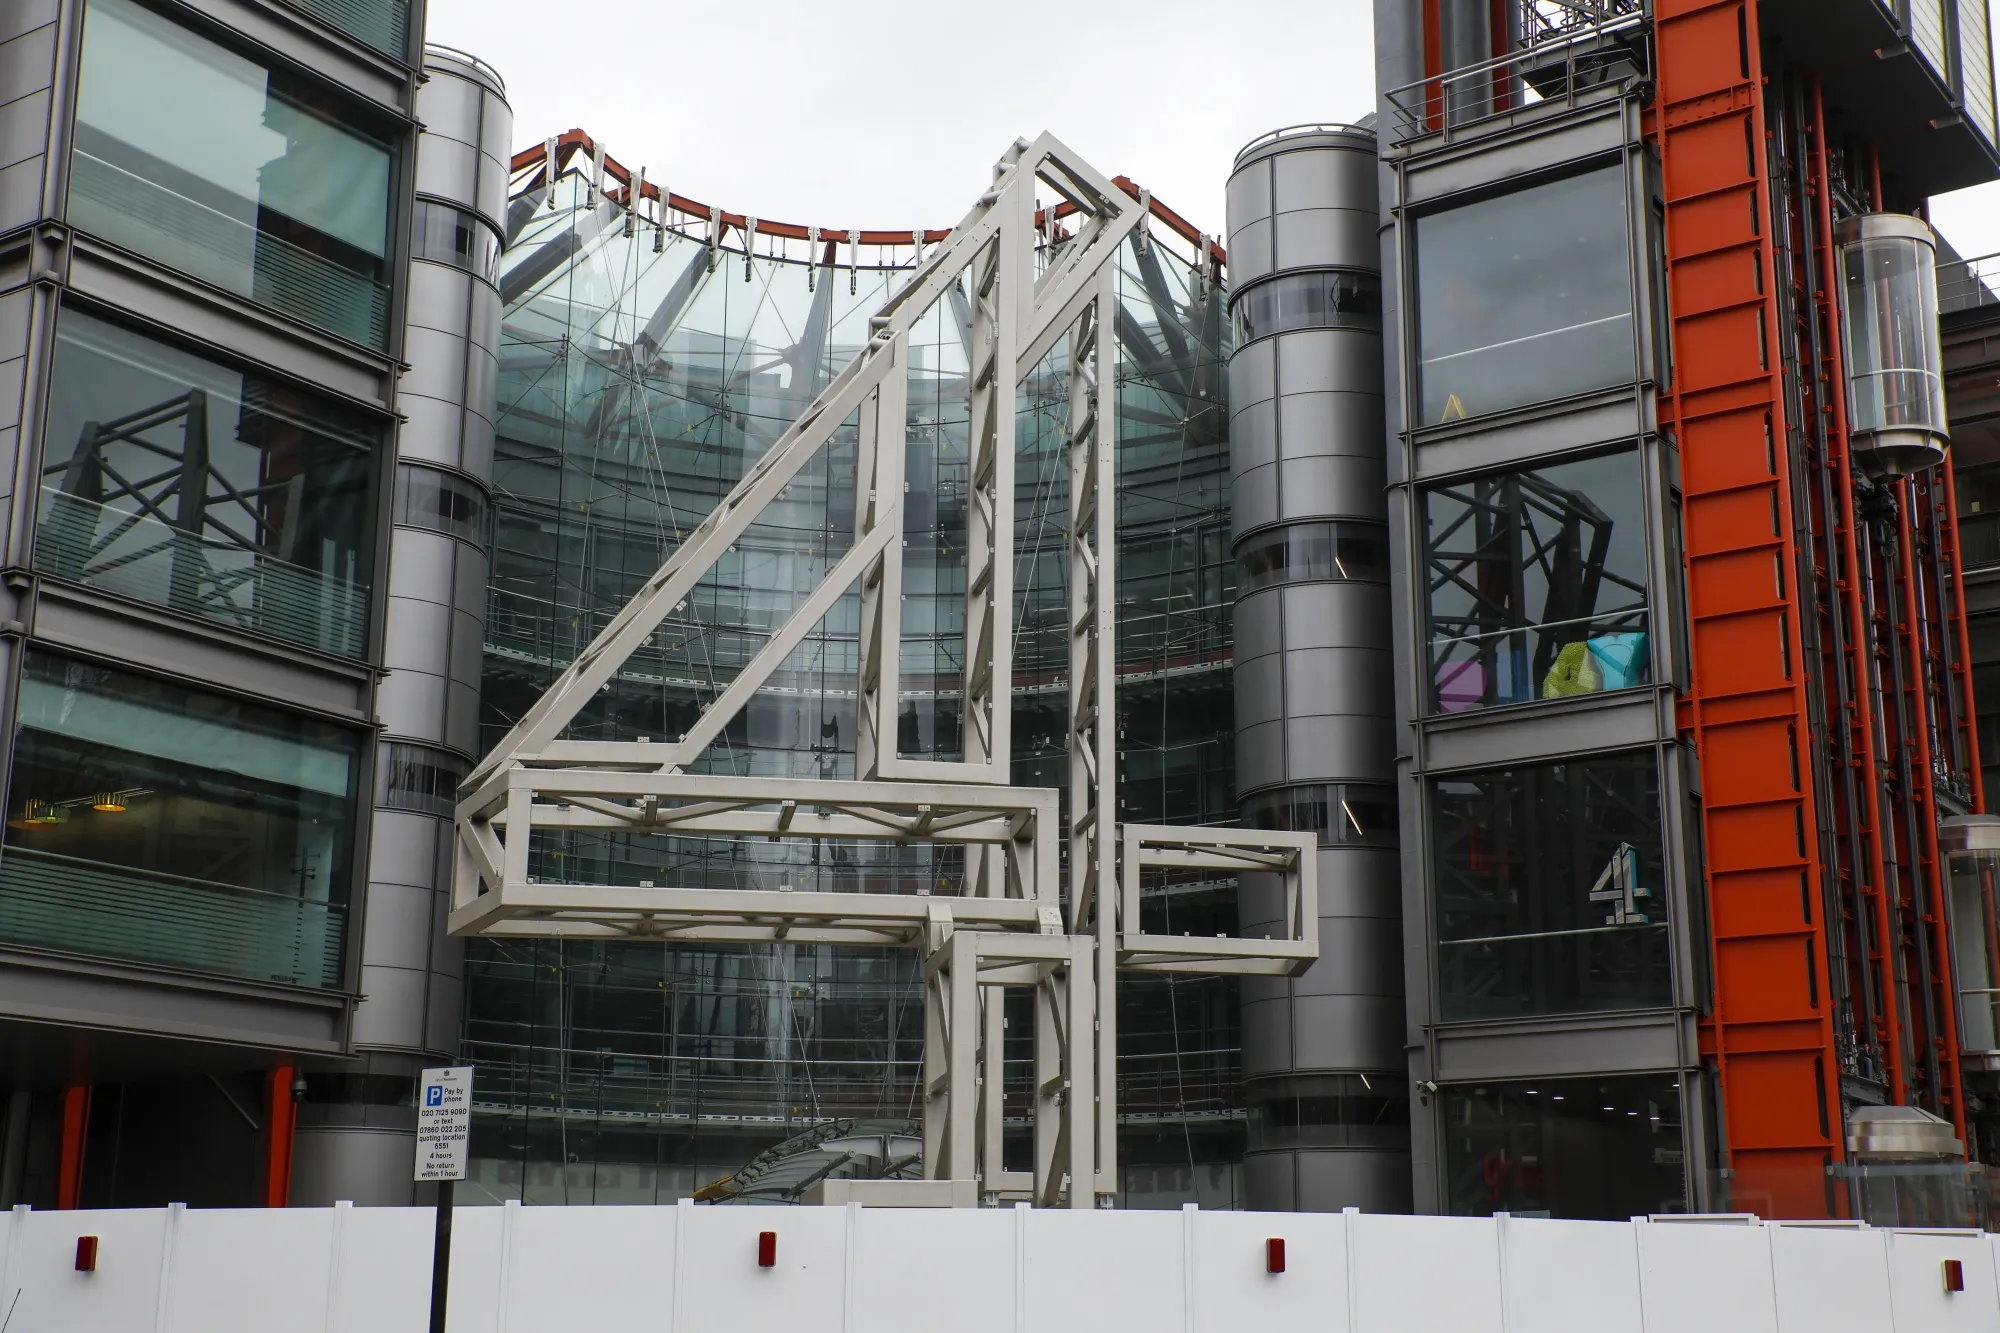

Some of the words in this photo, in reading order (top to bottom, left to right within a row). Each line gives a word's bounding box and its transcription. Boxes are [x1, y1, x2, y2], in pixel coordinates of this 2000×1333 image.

[444, 1088, 455, 1096] Pay
[456, 1087, 464, 1095] by
[444, 1096, 462, 1104] phone
[450, 1108, 467, 1116] 9090
[420, 1126, 440, 1134] 07860
[418, 1134, 441, 1142] quoting
